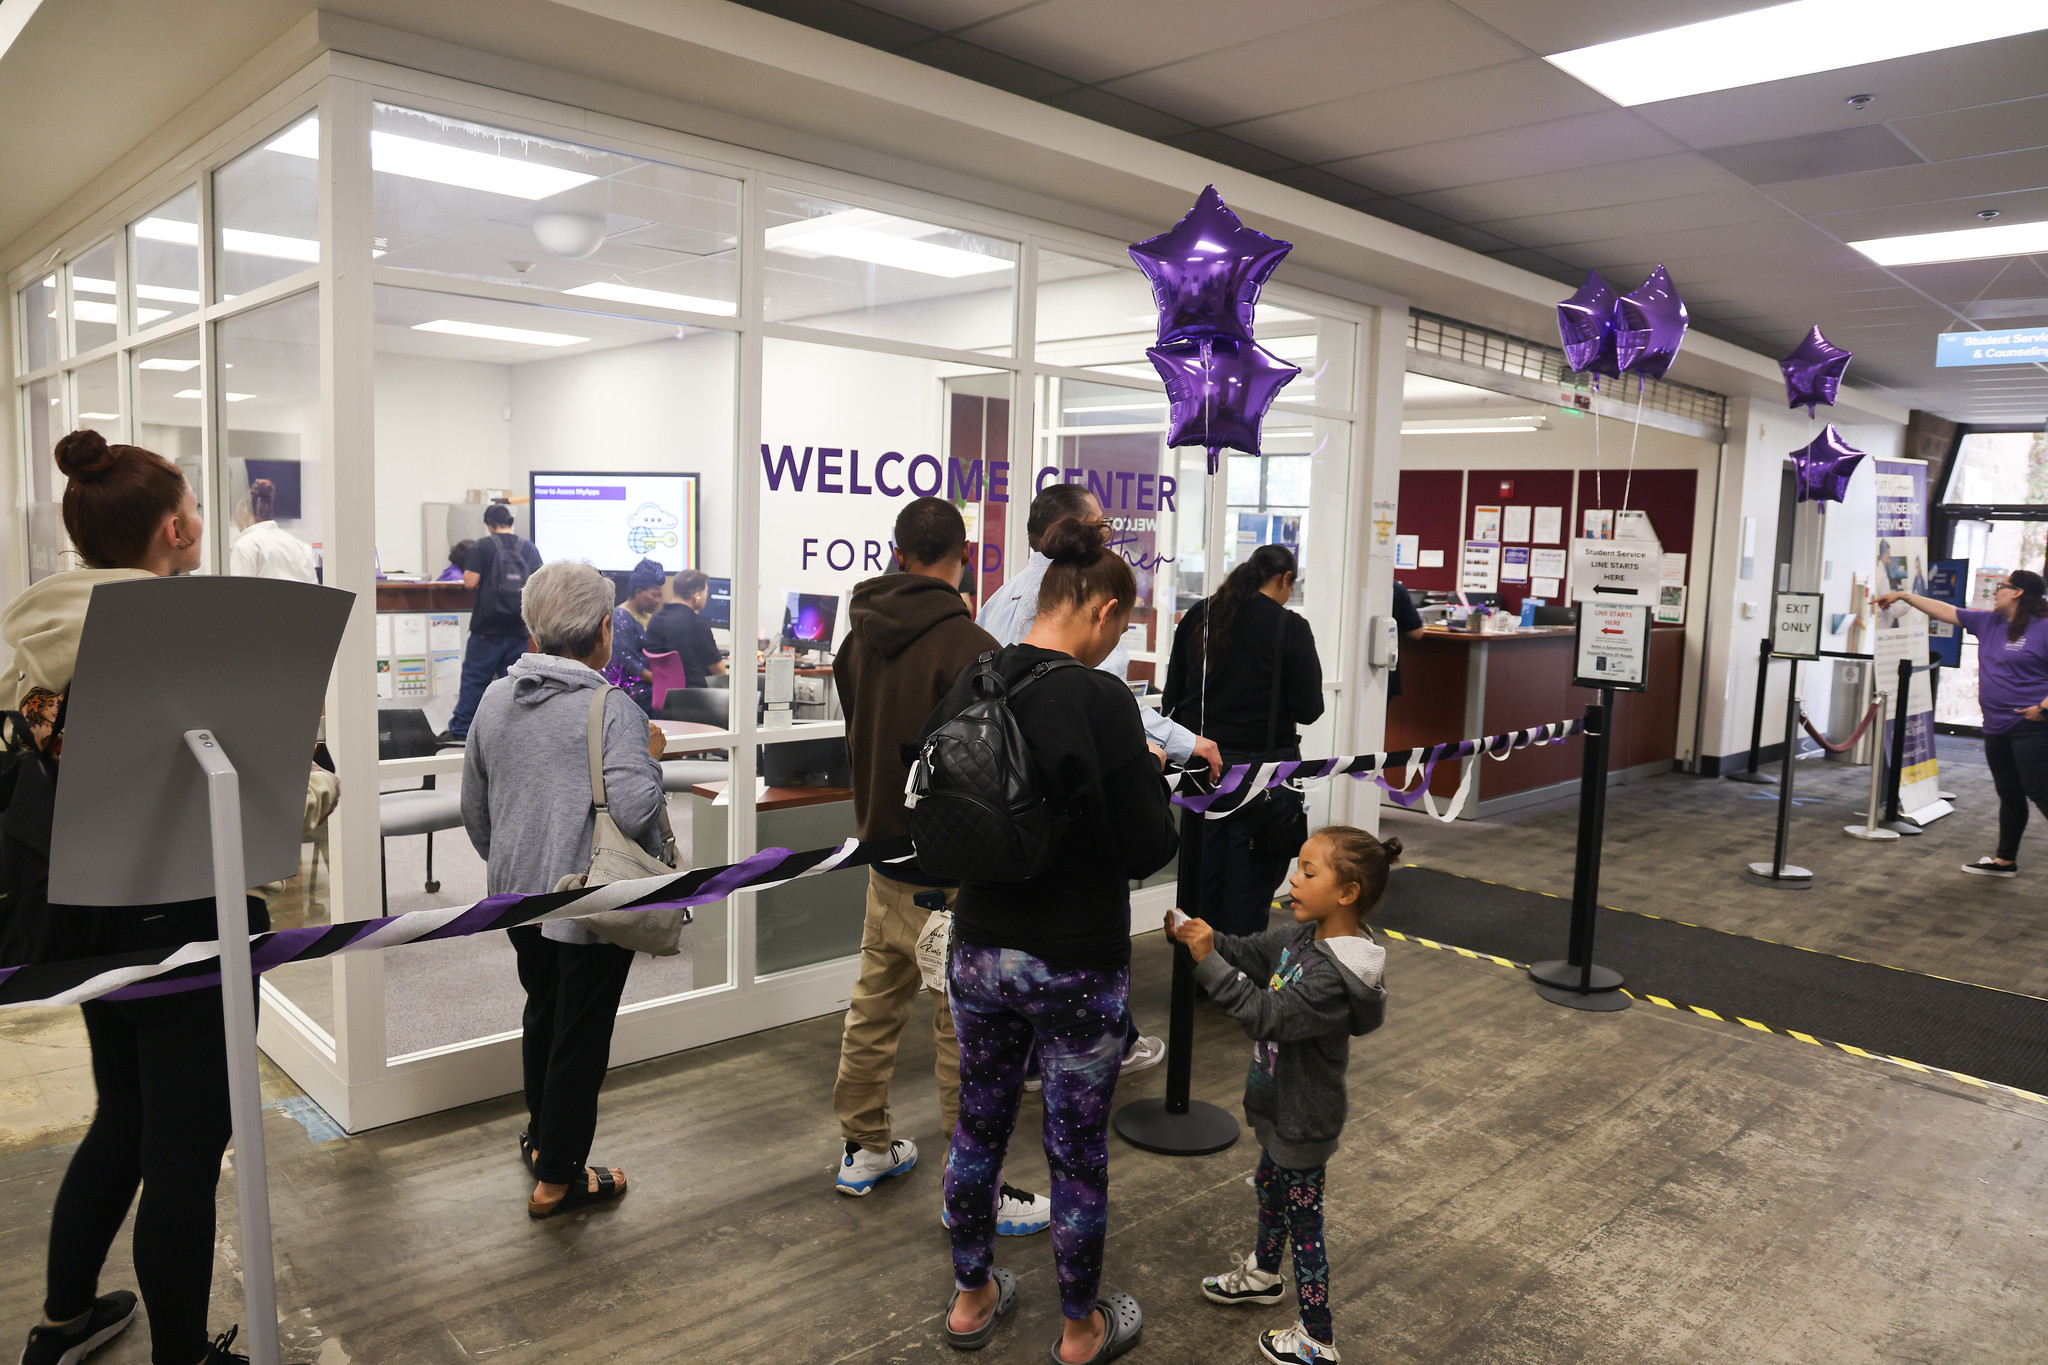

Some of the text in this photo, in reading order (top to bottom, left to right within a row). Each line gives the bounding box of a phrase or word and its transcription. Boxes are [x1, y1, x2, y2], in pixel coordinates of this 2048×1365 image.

[1963, 333, 2048, 346] Student Servic
[1972, 349, 1983, 359] &
[761, 443, 1010, 503] WELCOME
[1878, 501, 1921, 515] COUNSELING
[1877, 518, 1912, 531] SERVICES
[802, 538, 1002, 573] FORD
[1585, 548, 1646, 559] Student Service
[1591, 561, 1639, 570] LINE STARTS
[1786, 603, 1810, 614] EXIT
[1781, 622, 1812, 632] ONLY
